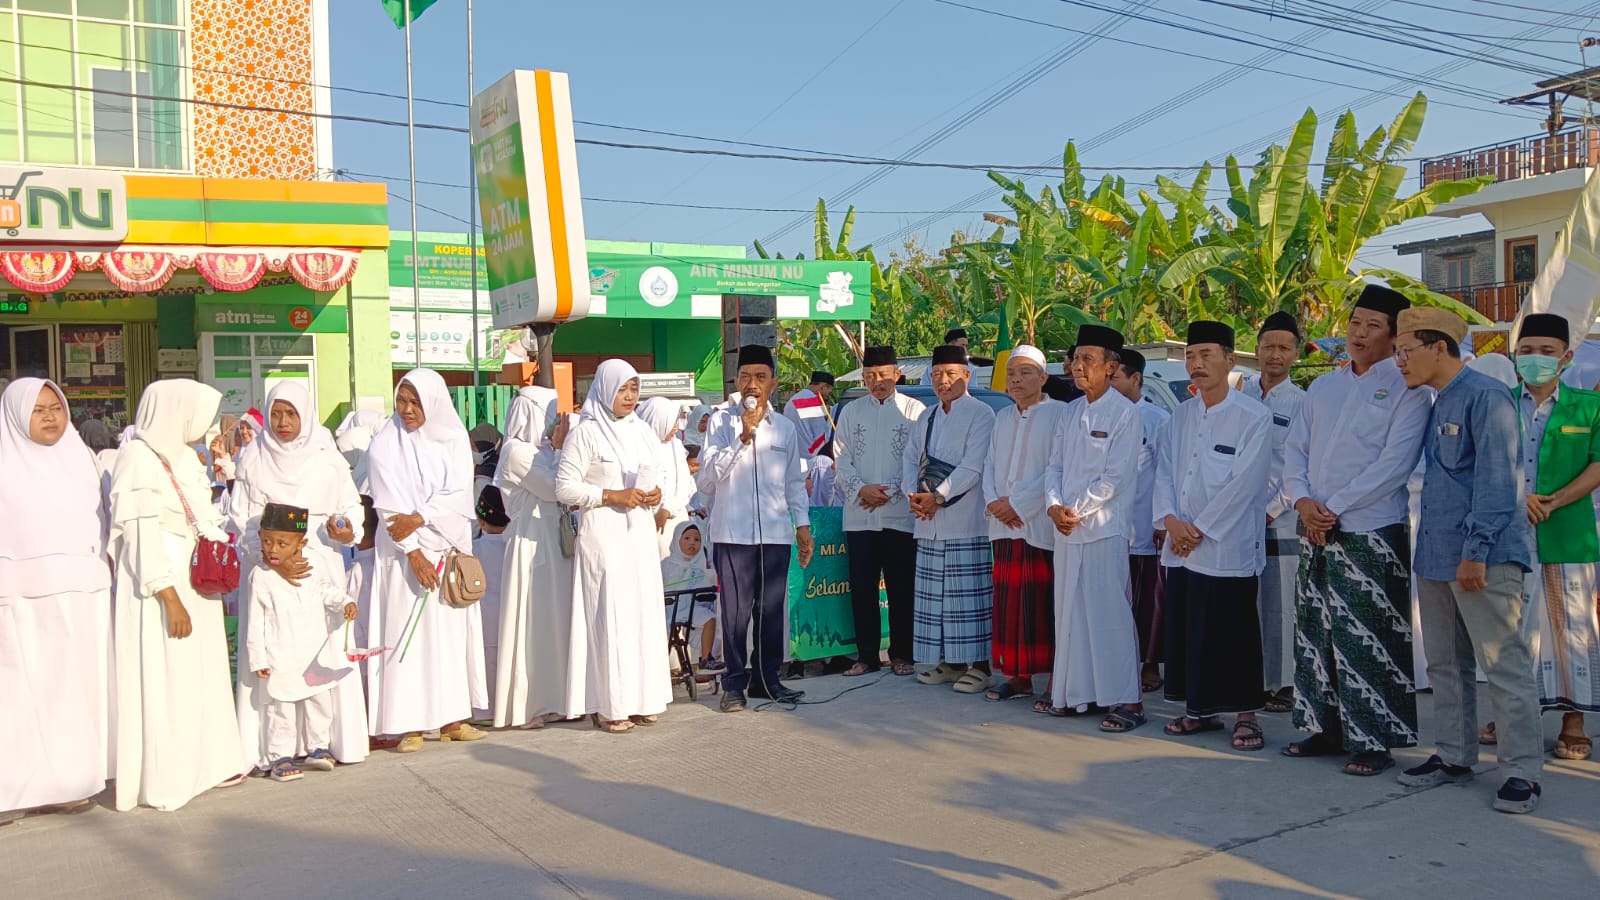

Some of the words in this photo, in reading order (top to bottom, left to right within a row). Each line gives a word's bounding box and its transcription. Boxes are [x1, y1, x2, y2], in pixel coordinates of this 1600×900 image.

[490, 197, 521, 235] ATM
[491, 236, 503, 256] 24
[504, 229, 525, 251] JAM
[690, 263, 719, 278] AIR
[723, 264, 777, 279] MINUM
[782, 265, 804, 280] NU
[215, 310, 251, 324] atm
[294, 311, 308, 320] 24
[820, 544, 835, 556] MI
